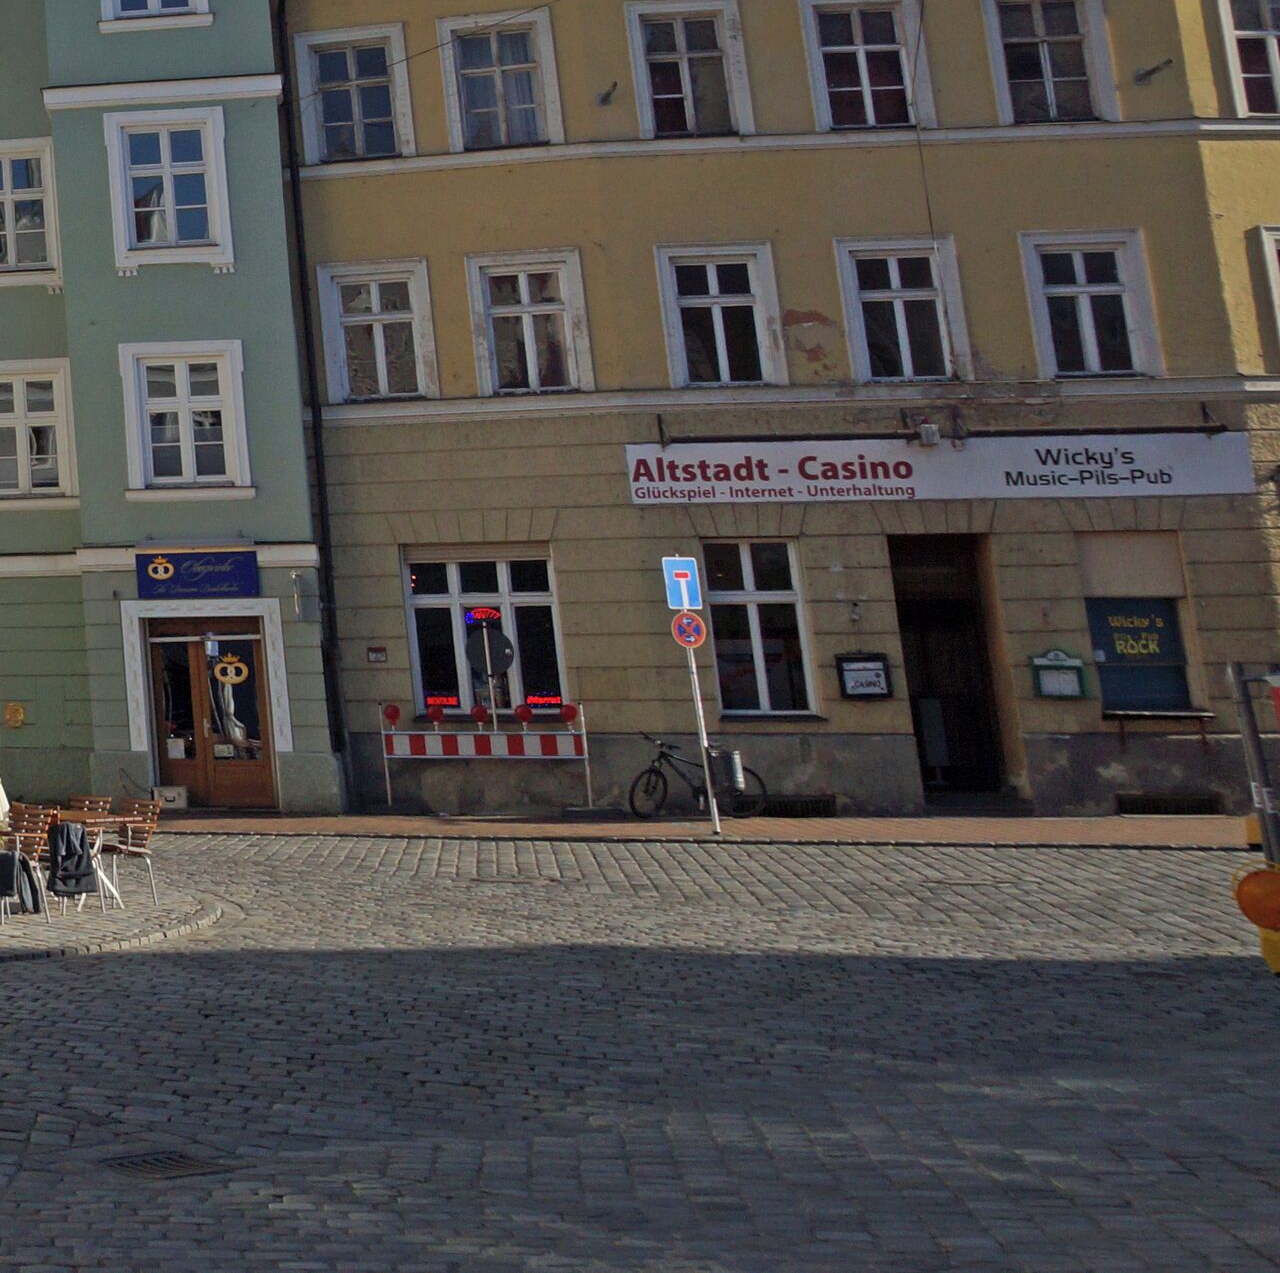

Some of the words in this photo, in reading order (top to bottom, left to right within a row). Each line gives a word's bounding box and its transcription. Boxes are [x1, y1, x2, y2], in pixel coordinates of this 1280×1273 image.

[632, 456, 770, 483] Altstadt
[797, 455, 913, 481] Casino
[1035, 447, 1136, 469] Wicky's
[634, 487, 716, 501] Glückspiel
[729, 485, 794, 498] Internet
[807, 484, 916, 500] Unterhaltung
